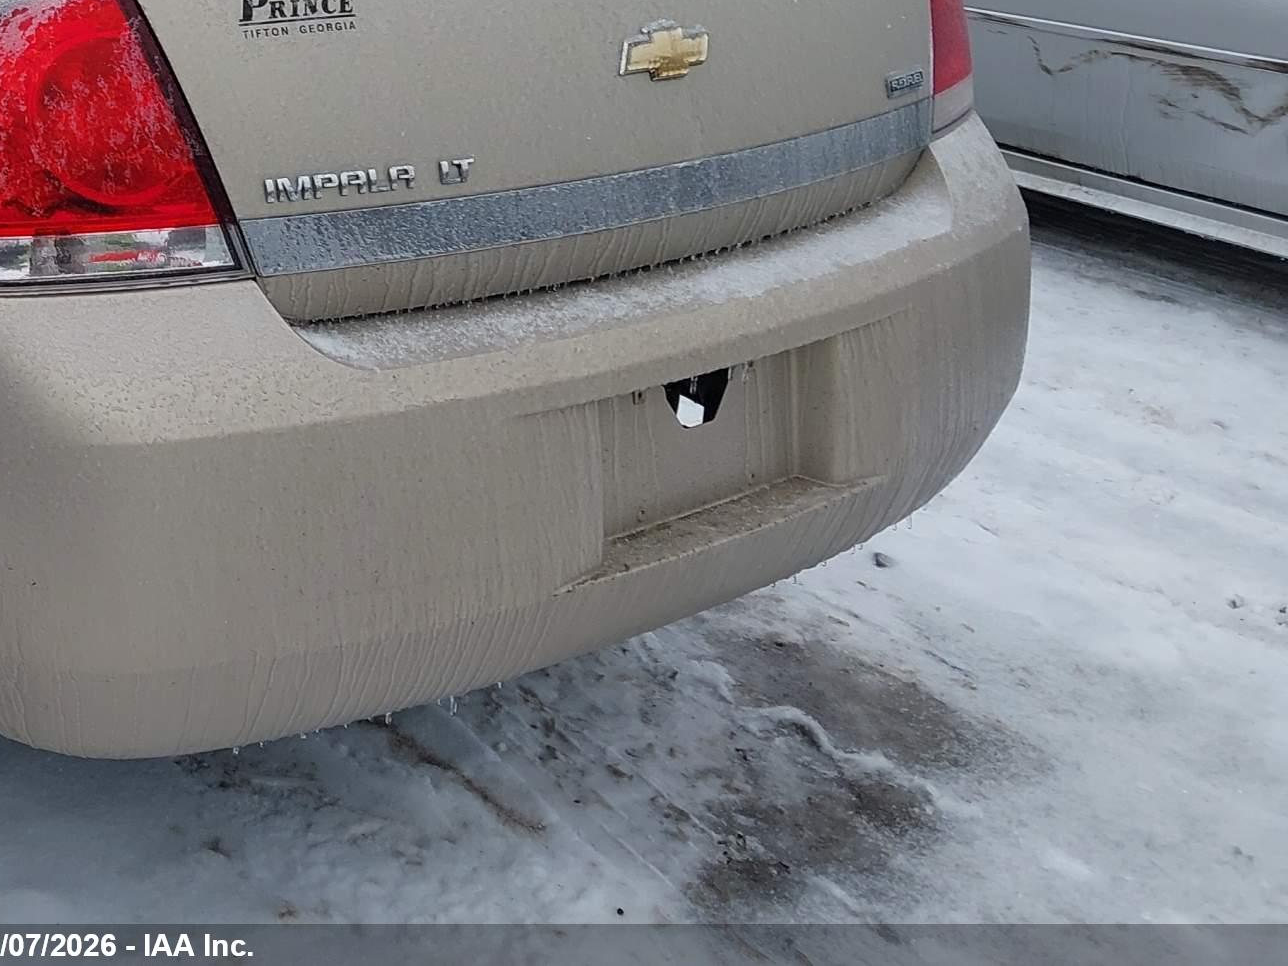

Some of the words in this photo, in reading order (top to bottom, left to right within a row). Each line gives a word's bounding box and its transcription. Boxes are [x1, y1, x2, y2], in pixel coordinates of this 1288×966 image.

[243, 27, 289, 40] TIFTON
[299, 20, 357, 35] GEORGIA
[264, 164, 416, 203] IMPALA
[438, 156, 475, 185] LT
